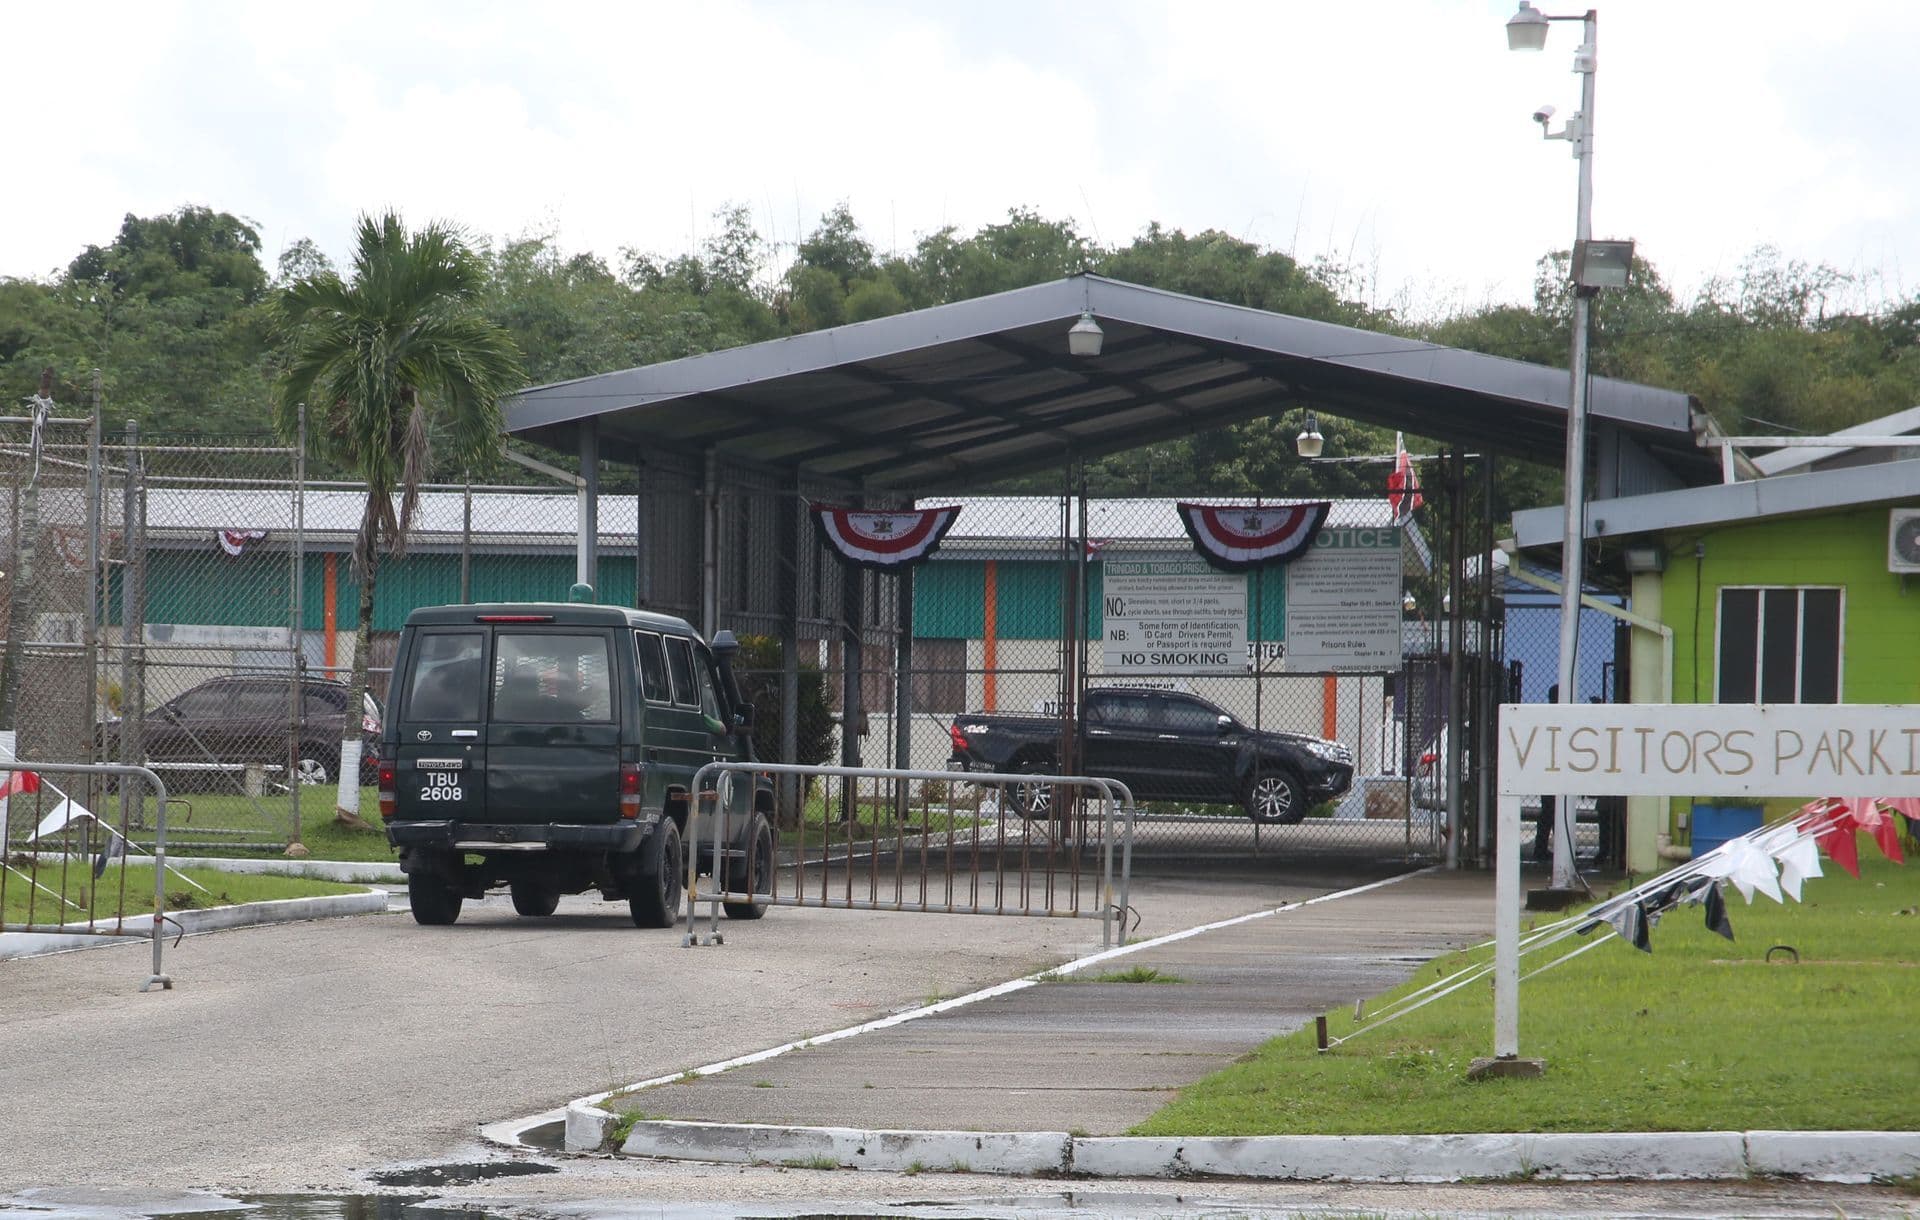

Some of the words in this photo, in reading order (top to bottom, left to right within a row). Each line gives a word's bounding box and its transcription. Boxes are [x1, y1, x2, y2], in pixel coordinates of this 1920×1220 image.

[1315, 529, 1393, 548] OTICE
[1106, 562, 1140, 574] TRINIDAD
[1142, 563, 1148, 574] &
[1150, 562, 1181, 574] TOBAGO
[1106, 597, 1127, 617] NO:
[1139, 621, 1160, 630] Some
[1161, 621, 1179, 630] form
[1180, 621, 1189, 630] of
[1190, 621, 1240, 631] Identification,
[1110, 630, 1129, 641] NB:
[1144, 631, 1153, 639] ID
[1154, 631, 1172, 639] Card
[1178, 631, 1206, 639] Drivers
[1207, 631, 1234, 640] Permit,
[1157, 641, 1190, 650] Passport
[1200, 641, 1232, 650] required
[1321, 640, 1346, 649] Prisons
[1347, 640, 1367, 649] Rules
[1121, 653, 1146, 665] NO
[1150, 653, 1228, 665] SMOKING
[1509, 726, 1755, 775] VISITORS
[426, 772, 458, 787] TBU
[420, 787, 463, 801] 2608
